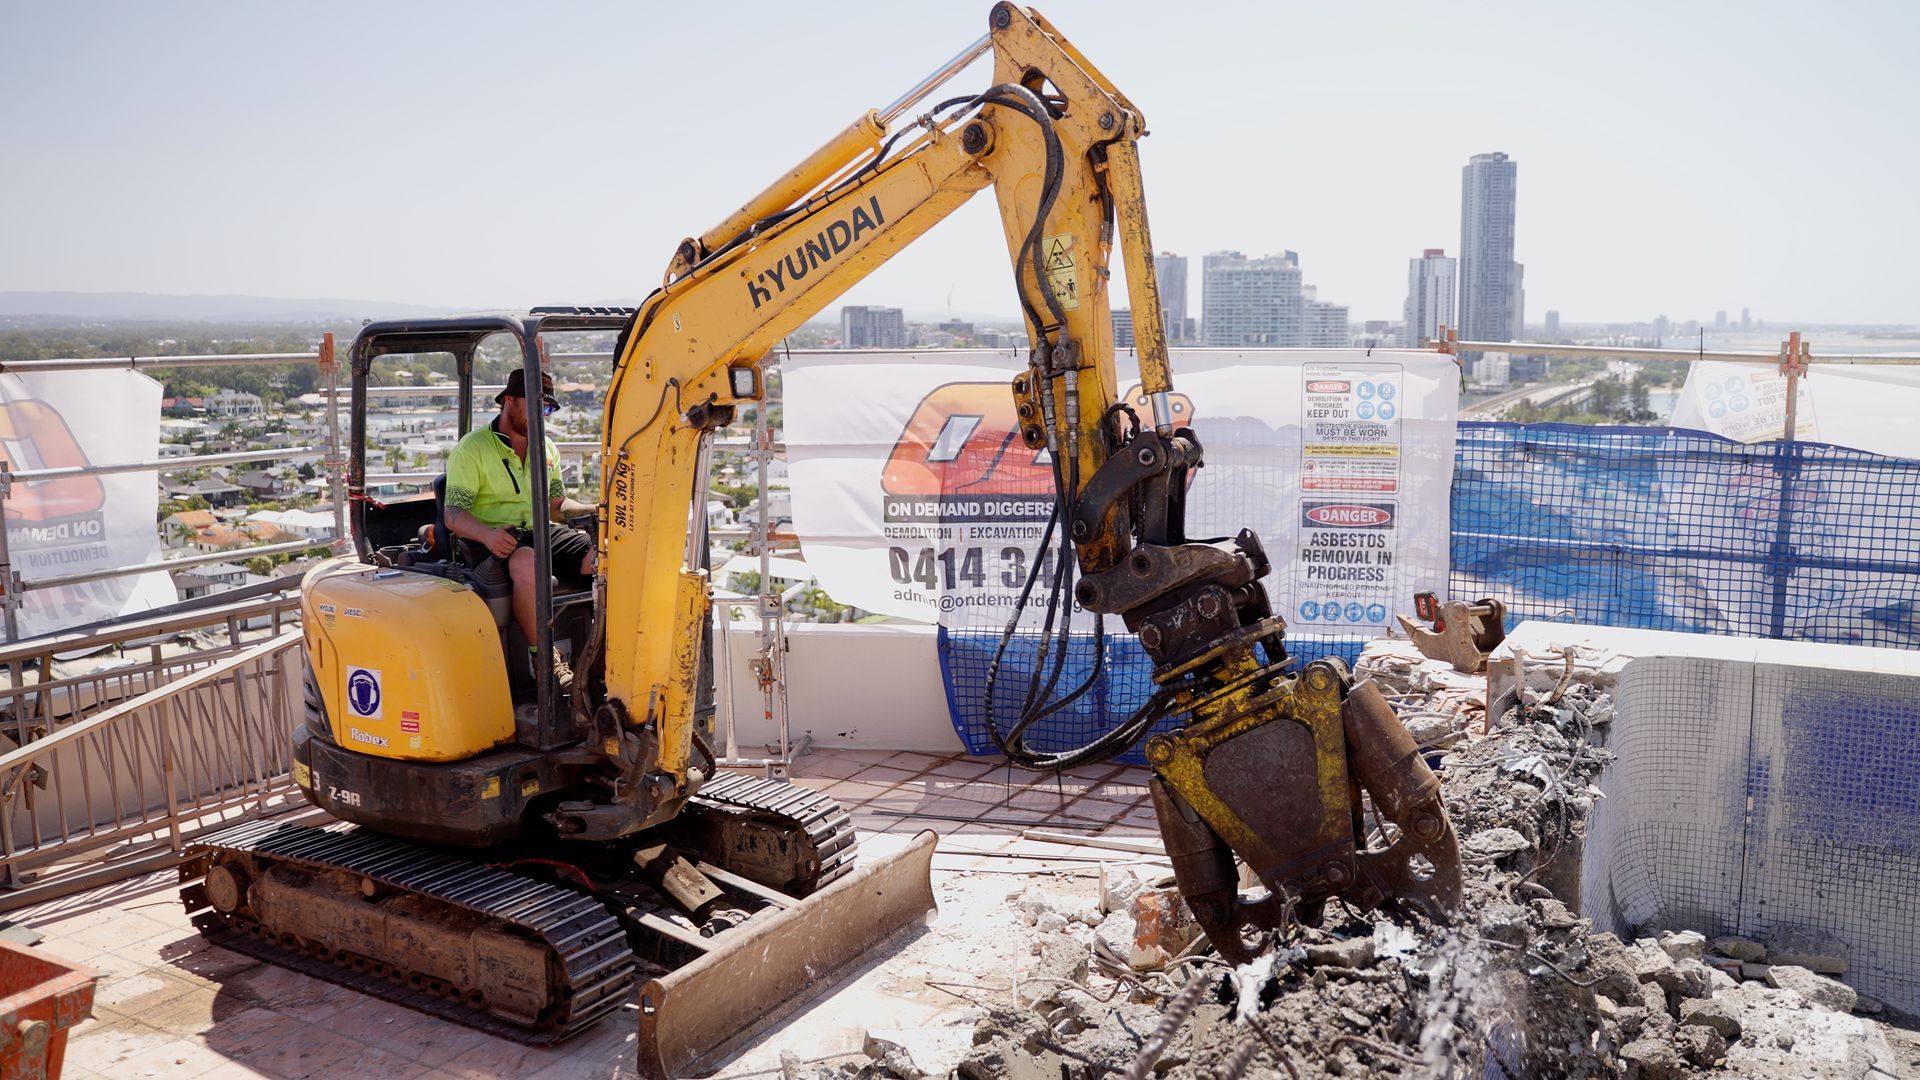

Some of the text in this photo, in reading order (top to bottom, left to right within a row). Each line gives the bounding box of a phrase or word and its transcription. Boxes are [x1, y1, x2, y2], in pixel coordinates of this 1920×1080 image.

[747, 195, 885, 309] HYUNDAI
[1313, 383, 1343, 391] DANGER
[1306, 409, 1349, 418] KEEP OUT
[1316, 428, 1341, 436] MUST
[1358, 429, 1388, 437] WORN
[615, 463, 630, 528] SWL 310 Kg
[888, 502, 1056, 517] ON DEMAND DIGGERS
[1319, 509, 1378, 522] DANGER
[884, 527, 1042, 539] DEMOLITION EXCAVATION
[1310, 532, 1386, 548] ASBESTOS
[1302, 549, 1392, 565] REMOVAL IN
[888, 546, 987, 590] 0414
[1307, 565, 1385, 582] PROGRESS
[1299, 582, 1390, 592] UNAUTHORISED PERSONS
